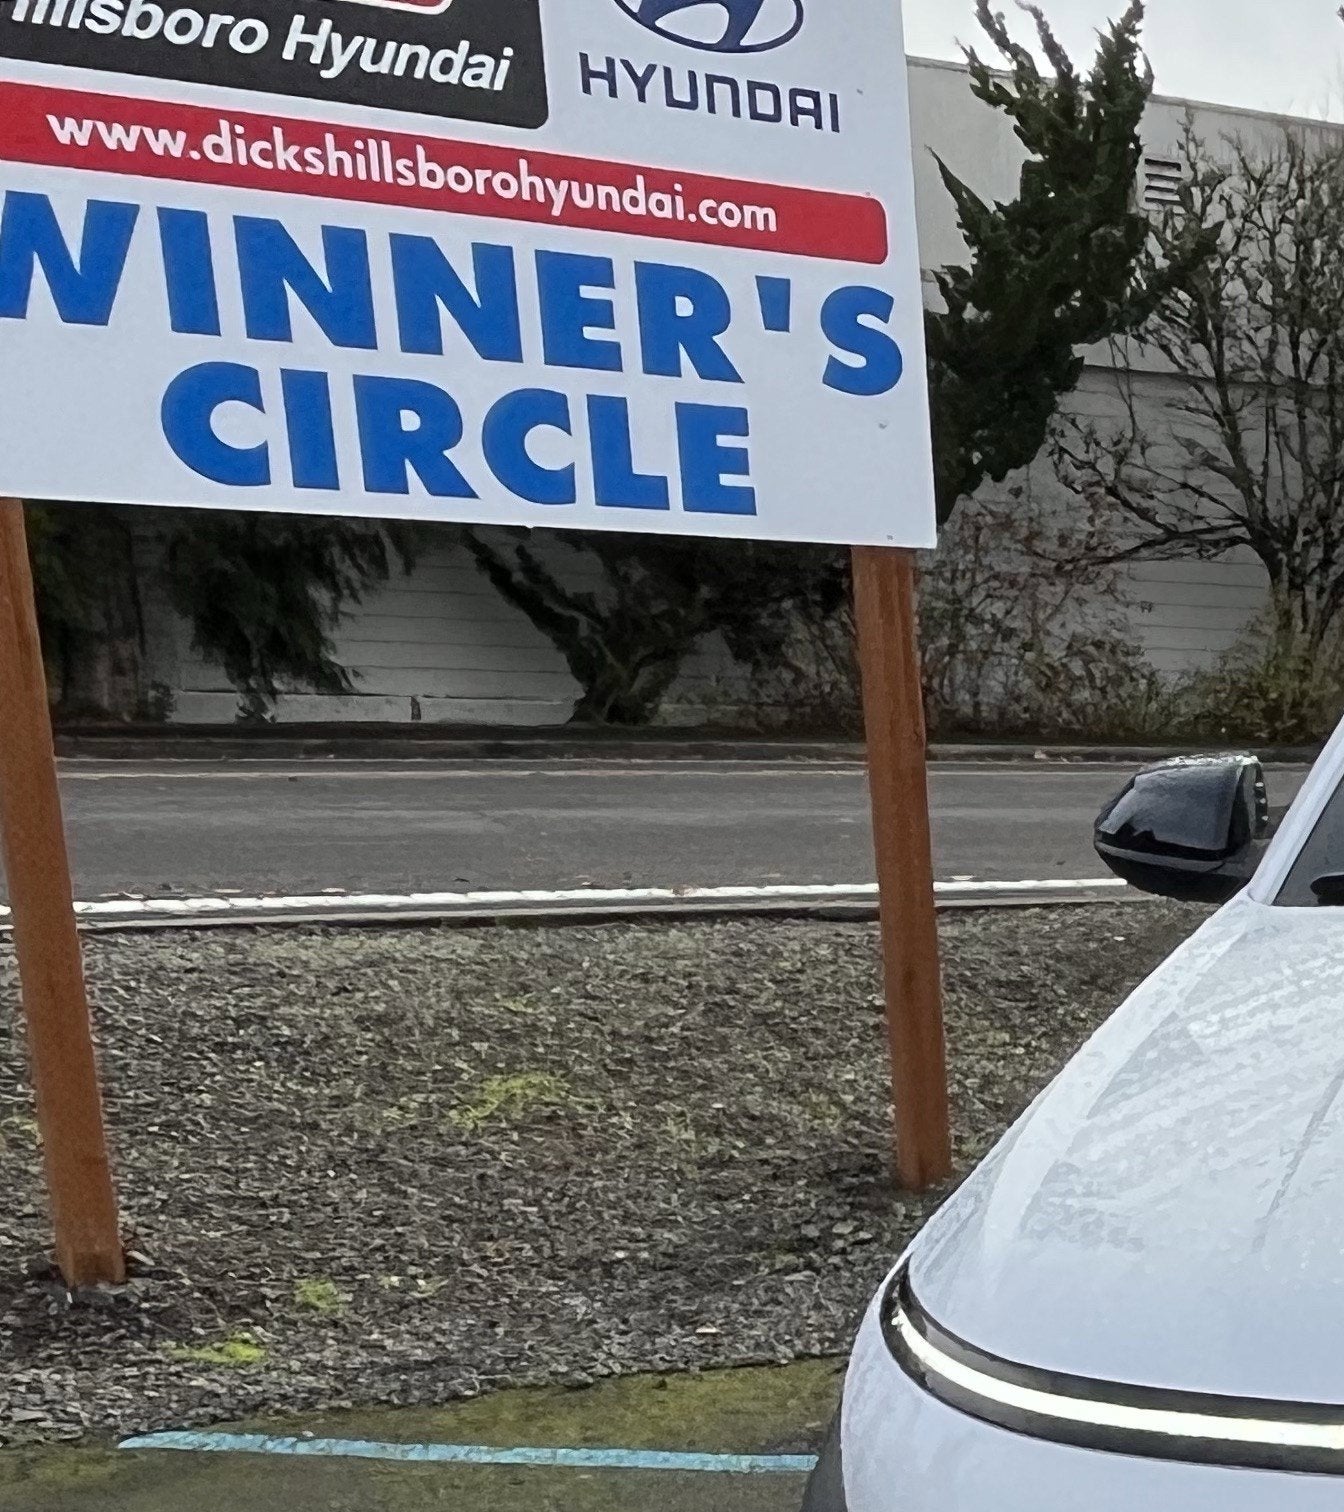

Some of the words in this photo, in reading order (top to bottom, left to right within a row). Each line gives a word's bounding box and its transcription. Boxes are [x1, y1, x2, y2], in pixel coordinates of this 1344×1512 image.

[11, 0, 269, 54] illsboro
[281, 13, 514, 92] Hyundai
[577, 52, 841, 134] HYUNDAI
[45, 110, 778, 234] www.dickshillsborohyundai.com
[0, 190, 904, 397] WINNER'S
[160, 361, 758, 517] CIRCLE
